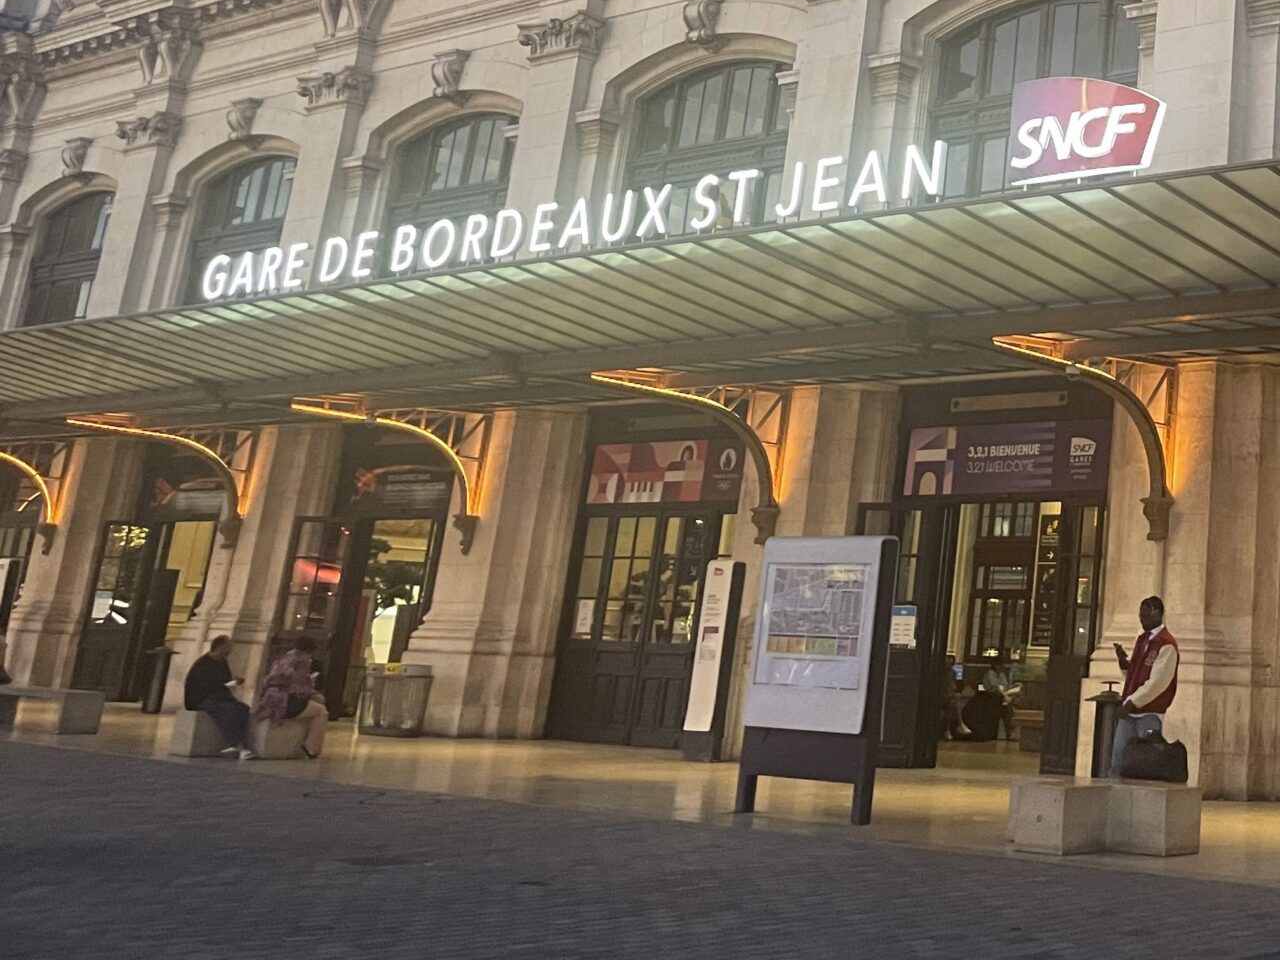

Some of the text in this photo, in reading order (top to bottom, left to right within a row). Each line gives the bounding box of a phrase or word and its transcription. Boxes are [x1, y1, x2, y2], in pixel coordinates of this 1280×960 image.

[1010, 102, 1146, 169] SNCF
[202, 140, 949, 300] GARE DE BORDEAUX ST JEAN
[985, 459, 1035, 473] WELCOME
[989, 443, 1041, 457] BIENVENUE
